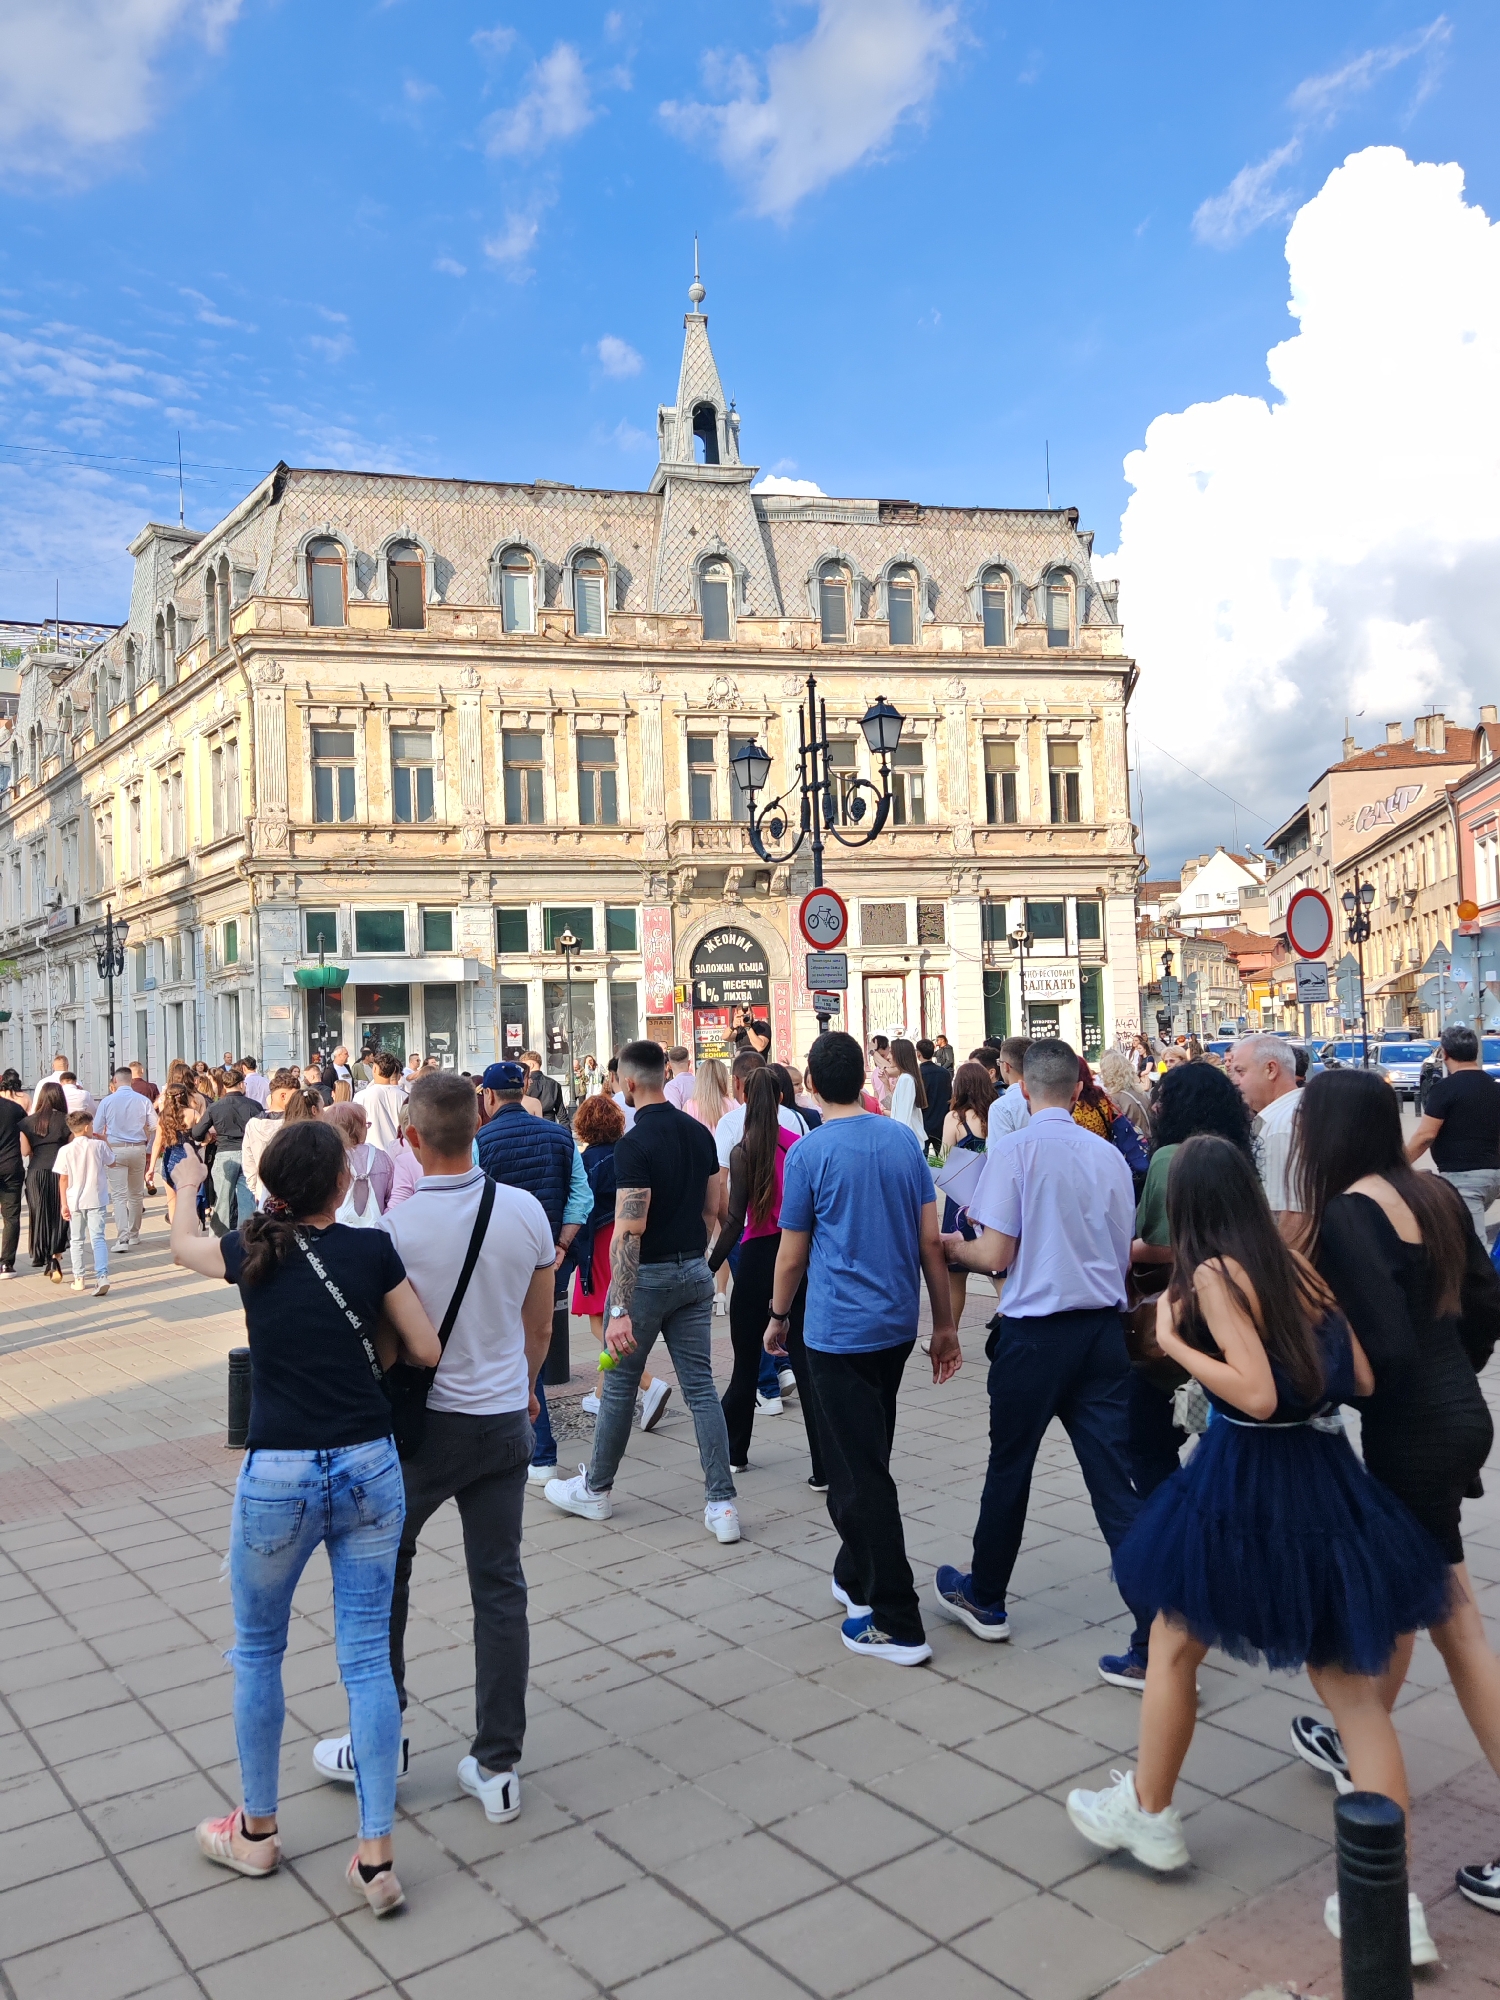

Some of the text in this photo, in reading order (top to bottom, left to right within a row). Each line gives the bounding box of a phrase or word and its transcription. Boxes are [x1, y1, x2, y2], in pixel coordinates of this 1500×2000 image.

[704, 934, 753, 954] ЖЕОНИК
[695, 962, 764, 973] ЗАЛОЖНА КЪЩА
[722, 979, 763, 990] МЕСЕЧНА
[1023, 978, 1076, 991] БАЛКАНЪ
[698, 981, 720, 1003] 1%
[724, 991, 753, 1002] ЛИХВА
[306, 1251, 327, 1280] adidas
[324, 1280, 347, 1309] adidas
